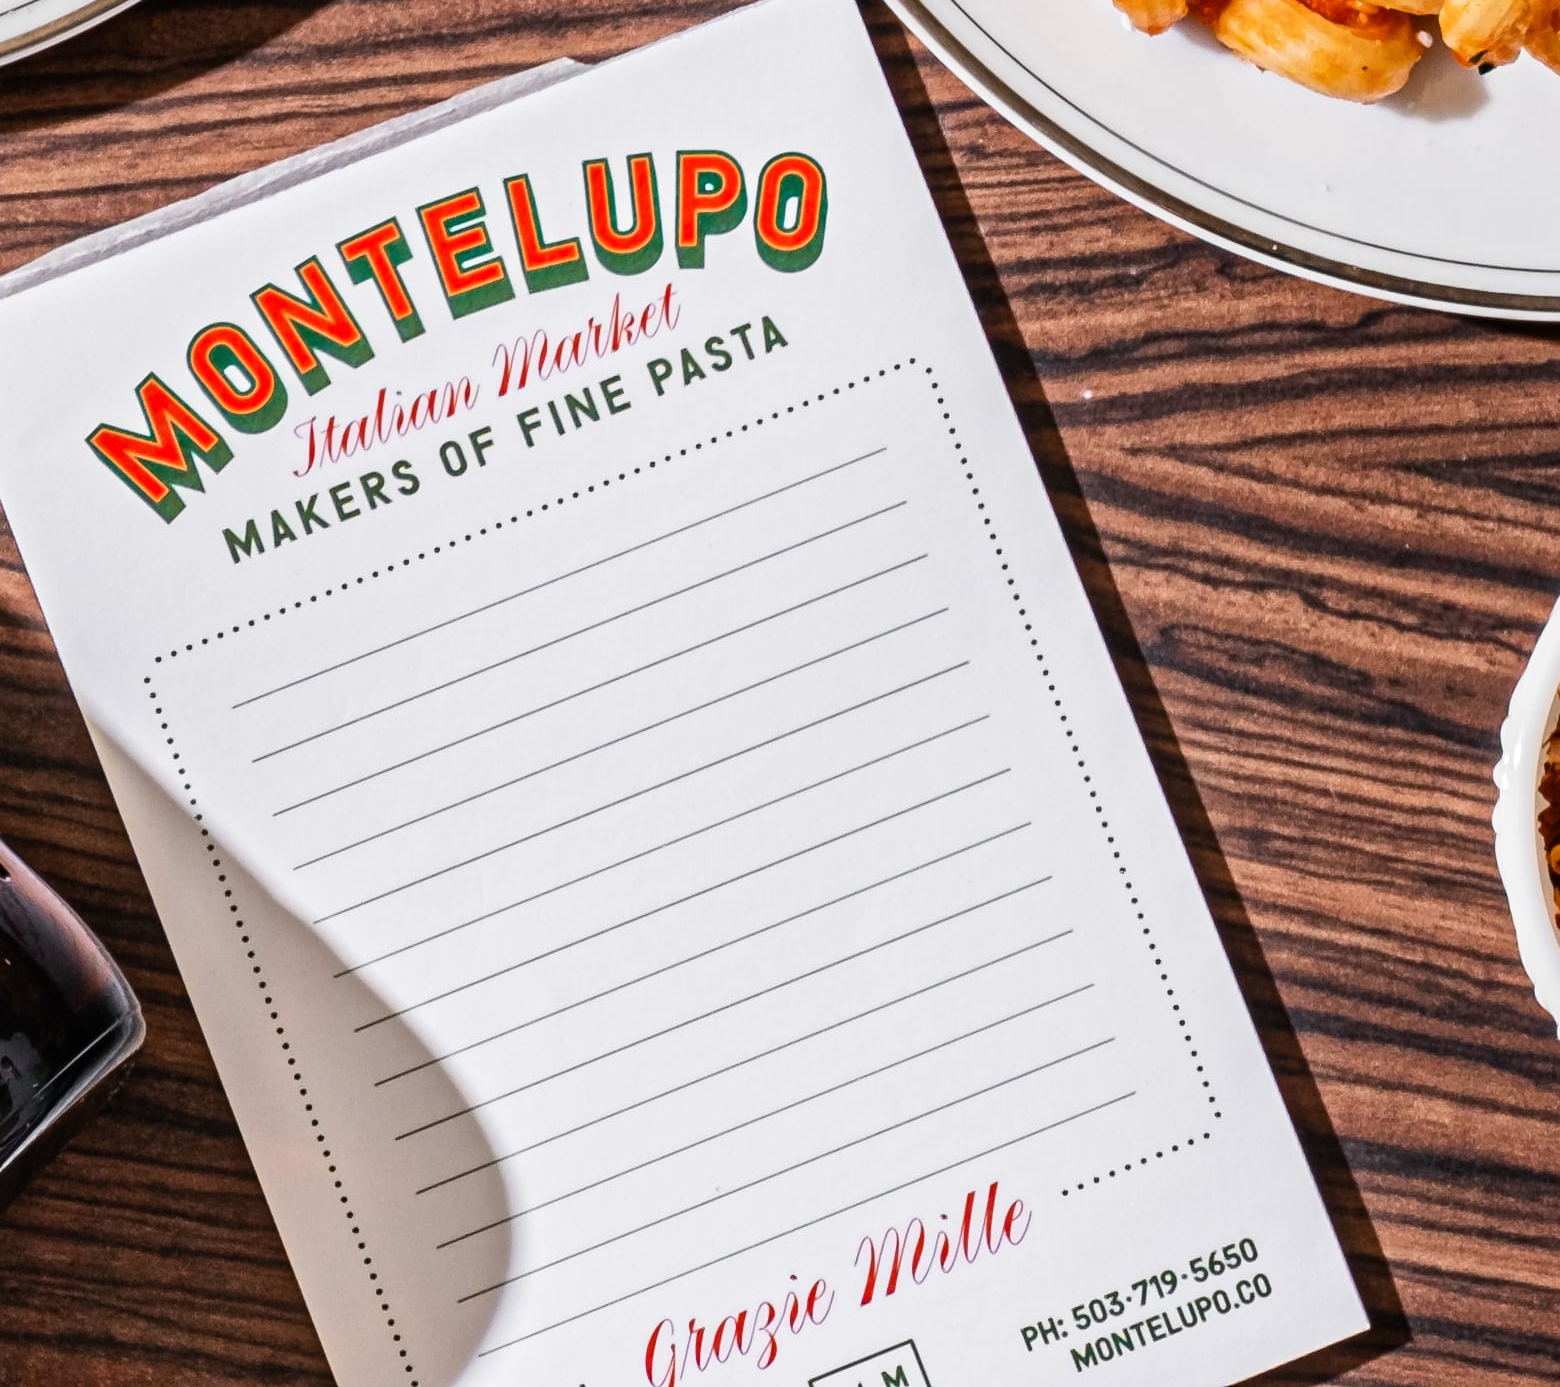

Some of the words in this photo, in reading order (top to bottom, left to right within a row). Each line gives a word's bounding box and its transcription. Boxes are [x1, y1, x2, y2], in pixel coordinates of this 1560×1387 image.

[85, 148, 829, 522] MONTELUPO
[292, 377, 477, 478] Italian
[492, 282, 682, 402] Market
[221, 458, 422, 566] MAKERS
[438, 426, 500, 484] OF
[521, 377, 631, 452] FINE
[649, 316, 790, 398] PASTA
[644, 1274, 835, 1387] Grazie
[851, 1181, 1032, 1310] Mille
[1021, 1310, 1069, 1353] PH:
[1071, 1272, 1274, 1371] MONTELUPO.CO
